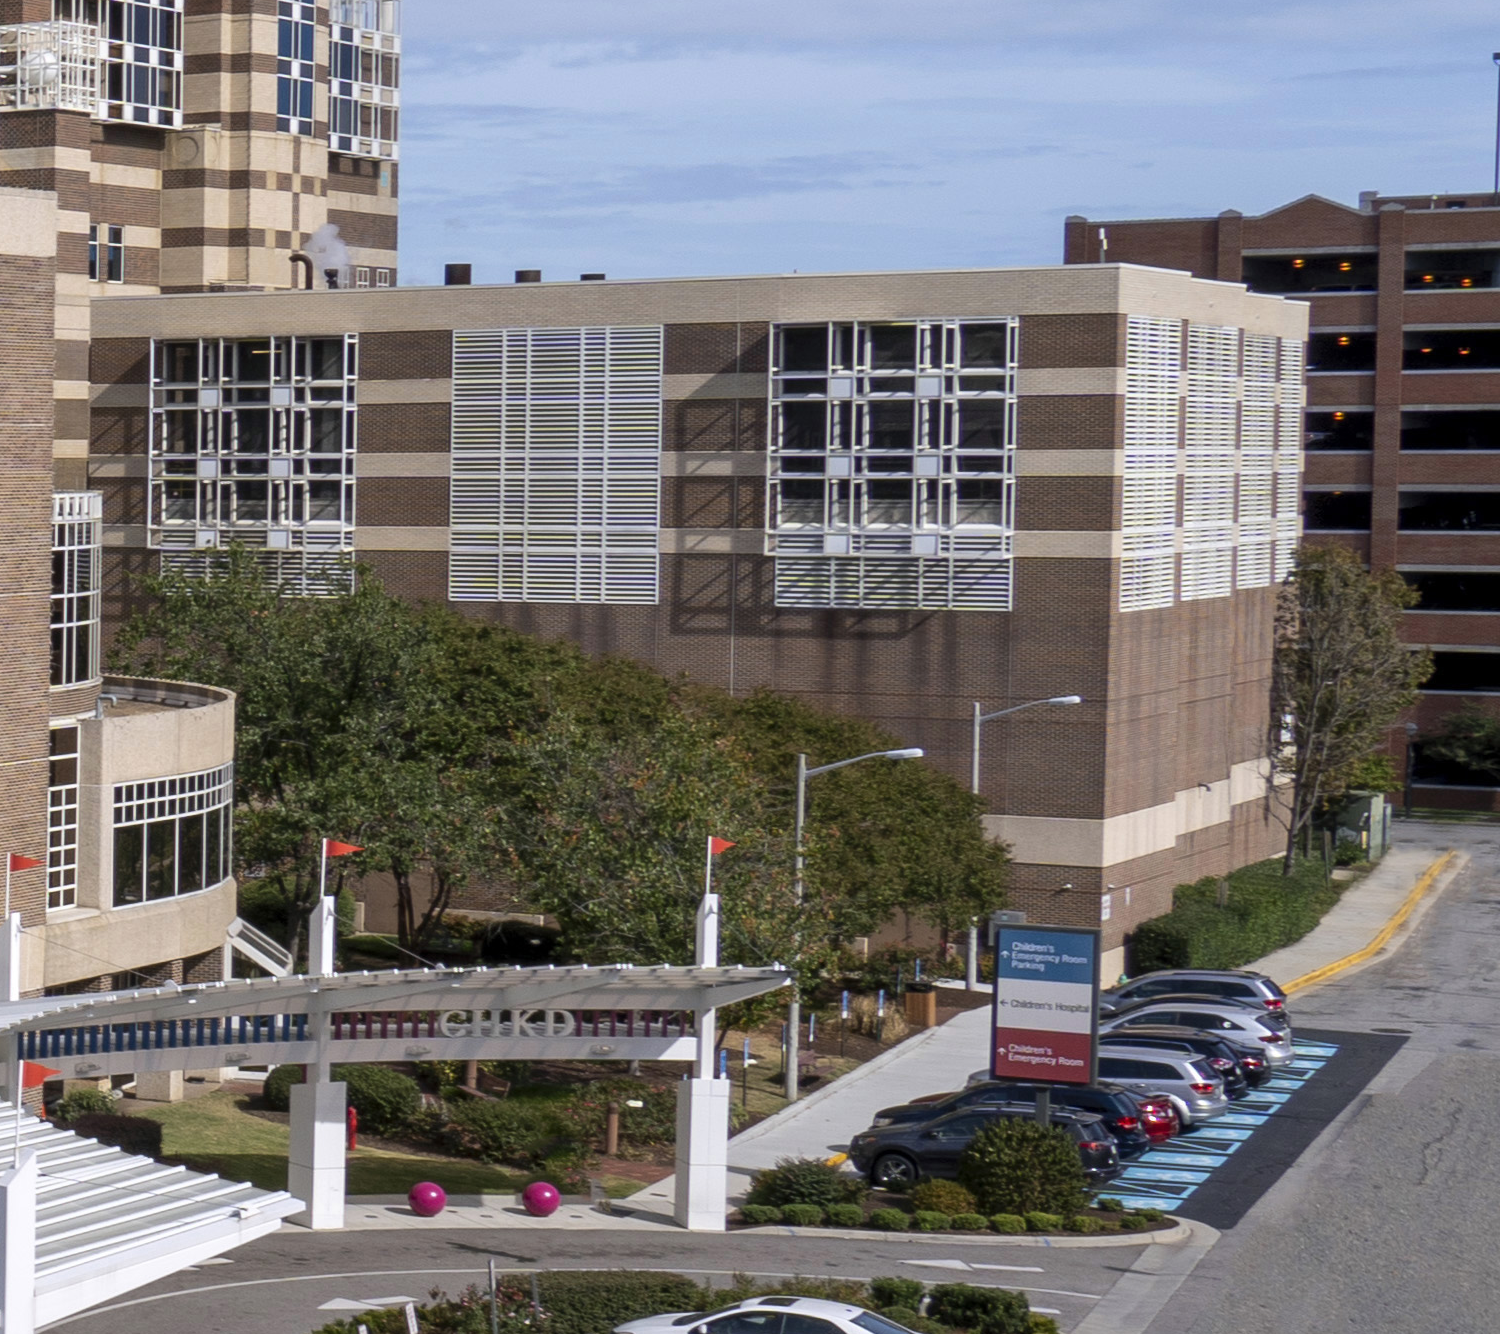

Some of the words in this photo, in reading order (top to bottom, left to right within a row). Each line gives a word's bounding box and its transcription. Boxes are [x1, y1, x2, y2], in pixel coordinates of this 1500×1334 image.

[1011, 941, 1055, 953] Children's
[1011, 951, 1060, 964] Emergency
[1062, 954, 1088, 964] Room
[1011, 961, 1045, 972] Parking
[1010, 999, 1053, 1011] Children's
[1055, 1002, 1090, 1013] Hospital
[439, 1009, 575, 1038] CHKD
[1008, 1044, 1053, 1055] Children's
[1008, 1053, 1057, 1066] Emergency
[1058, 1056, 1084, 1066] Room
